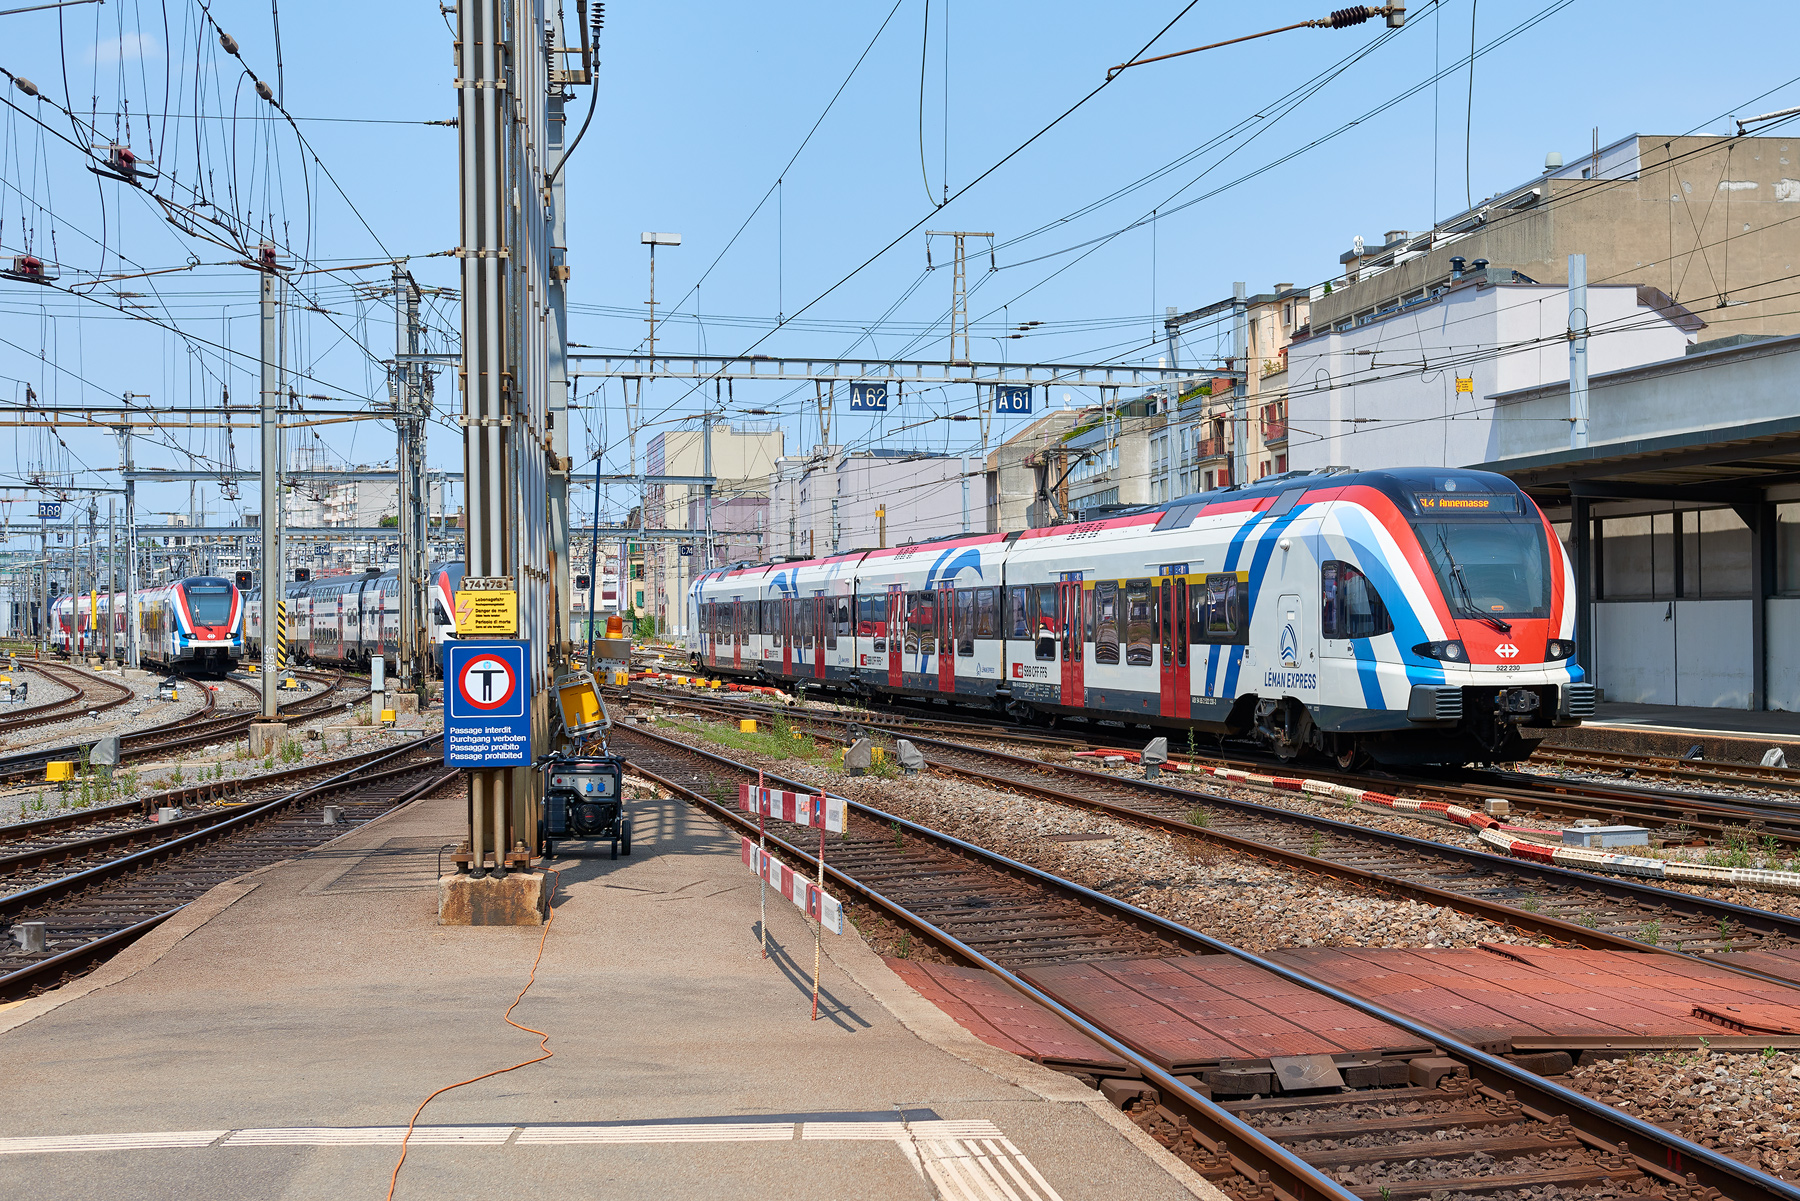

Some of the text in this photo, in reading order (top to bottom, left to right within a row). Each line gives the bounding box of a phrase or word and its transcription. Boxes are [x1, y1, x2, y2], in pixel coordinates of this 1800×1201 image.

[852, 387, 886, 408] A 62
[998, 391, 1030, 410] A 61
[1440, 498, 1488, 508] Annemasse
[681, 546, 694, 555] C74
[469, 580, 481, 588] 74
[490, 580, 502, 588] 73
[1196, 602, 1200, 622] 1
[1024, 665, 1032, 677] SBB
[1264, 668, 1316, 690] LÉMAN EXPRESS
[450, 727, 482, 735] Passage
[450, 743, 520, 752] Passaggio proibito
[484, 752, 523, 760] prohibited
